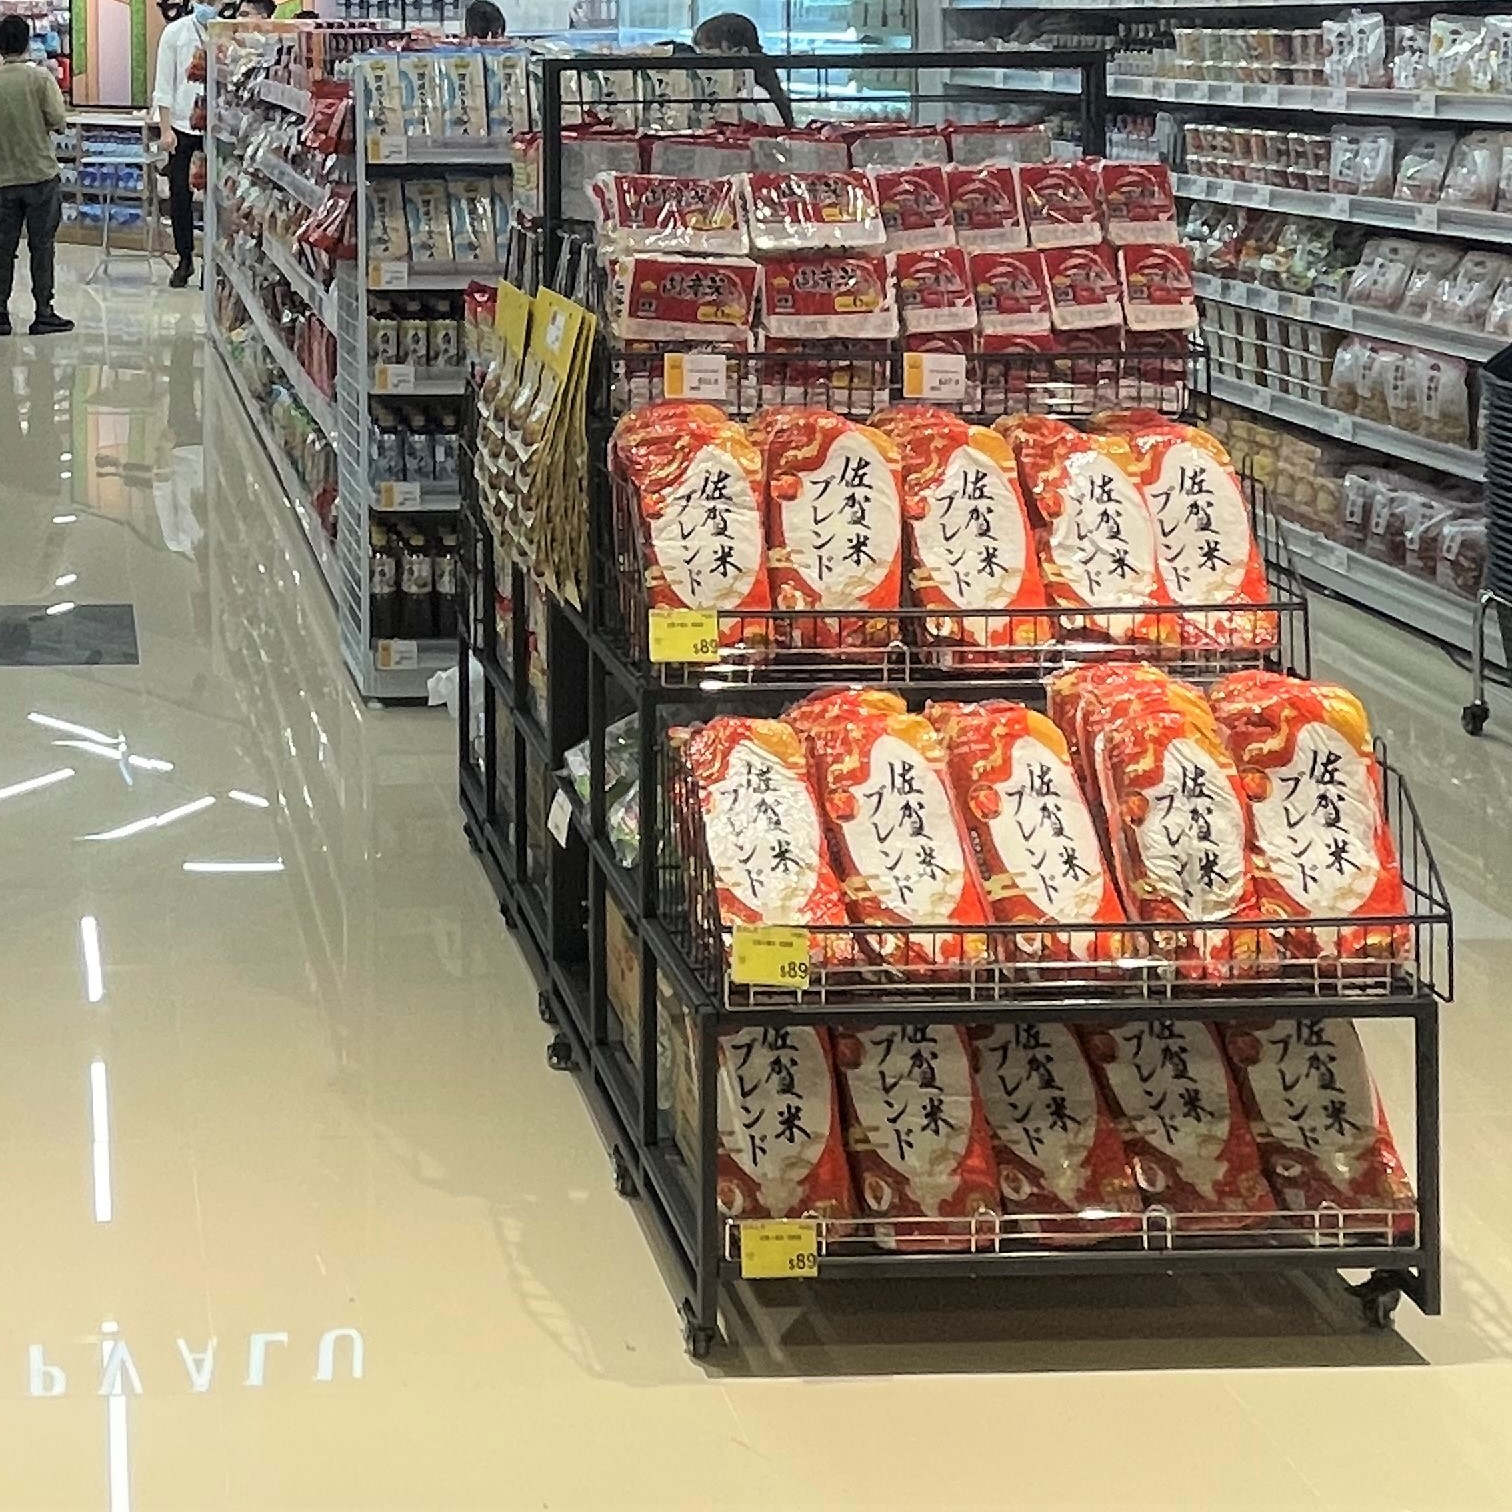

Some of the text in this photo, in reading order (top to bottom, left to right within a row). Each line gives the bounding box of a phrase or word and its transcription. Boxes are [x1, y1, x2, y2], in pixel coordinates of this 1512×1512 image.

[699, 469, 742, 578] 佐賀米
[809, 474, 836, 582] ブレンド
[837, 455, 877, 567] 佐賀米
[961, 469, 1010, 578] 佐賀米
[1089, 473, 1140, 579] 佐賀米
[1151, 485, 1192, 592] ブレンド
[1179, 465, 1232, 572] 佐賀米
[692, 638, 719, 655] $89
[745, 761, 803, 874] 佐賀米
[863, 785, 914, 905] ブレンド
[888, 760, 951, 882] 佐賀米
[1005, 784, 1059, 905] ブレンド
[1027, 762, 1091, 882] 佐賀米
[1181, 764, 1229, 889] 佐賀米
[1279, 771, 1319, 894] ブレンド
[1309, 748, 1362, 876] 佐賀米
[780, 961, 808, 979] $89
[731, 1037, 768, 1167] ブレンド
[871, 1031, 914, 1162] ブレンド
[988, 1040, 1046, 1156] ブレンド
[1123, 1029, 1180, 1145] ブレンド
[1268, 1034, 1320, 1149] ブレンド
[789, 1252, 816, 1271] $89
